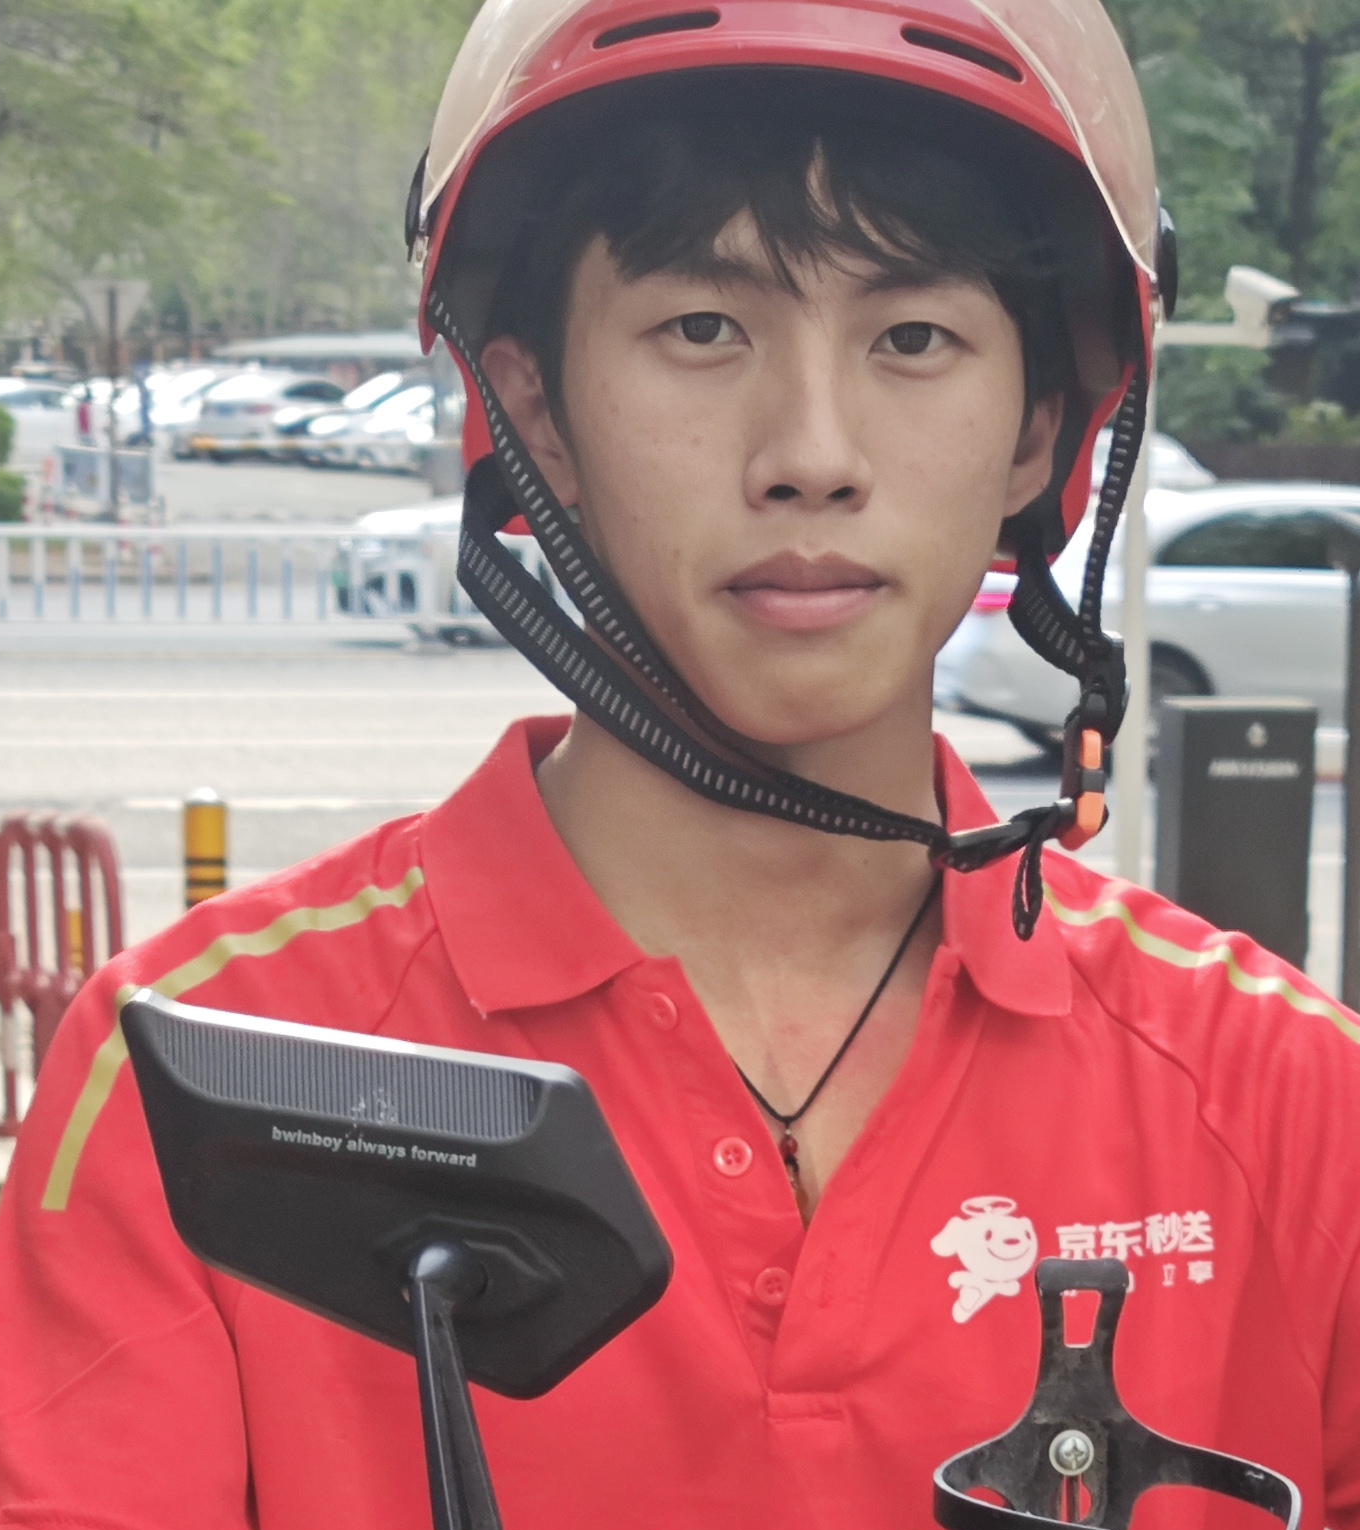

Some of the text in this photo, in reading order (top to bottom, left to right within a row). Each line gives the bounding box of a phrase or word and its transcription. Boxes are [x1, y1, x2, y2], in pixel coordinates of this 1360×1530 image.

[271, 1125, 477, 1168] bwinboy always forward
[1055, 1210, 1215, 1262] 京东秒送
